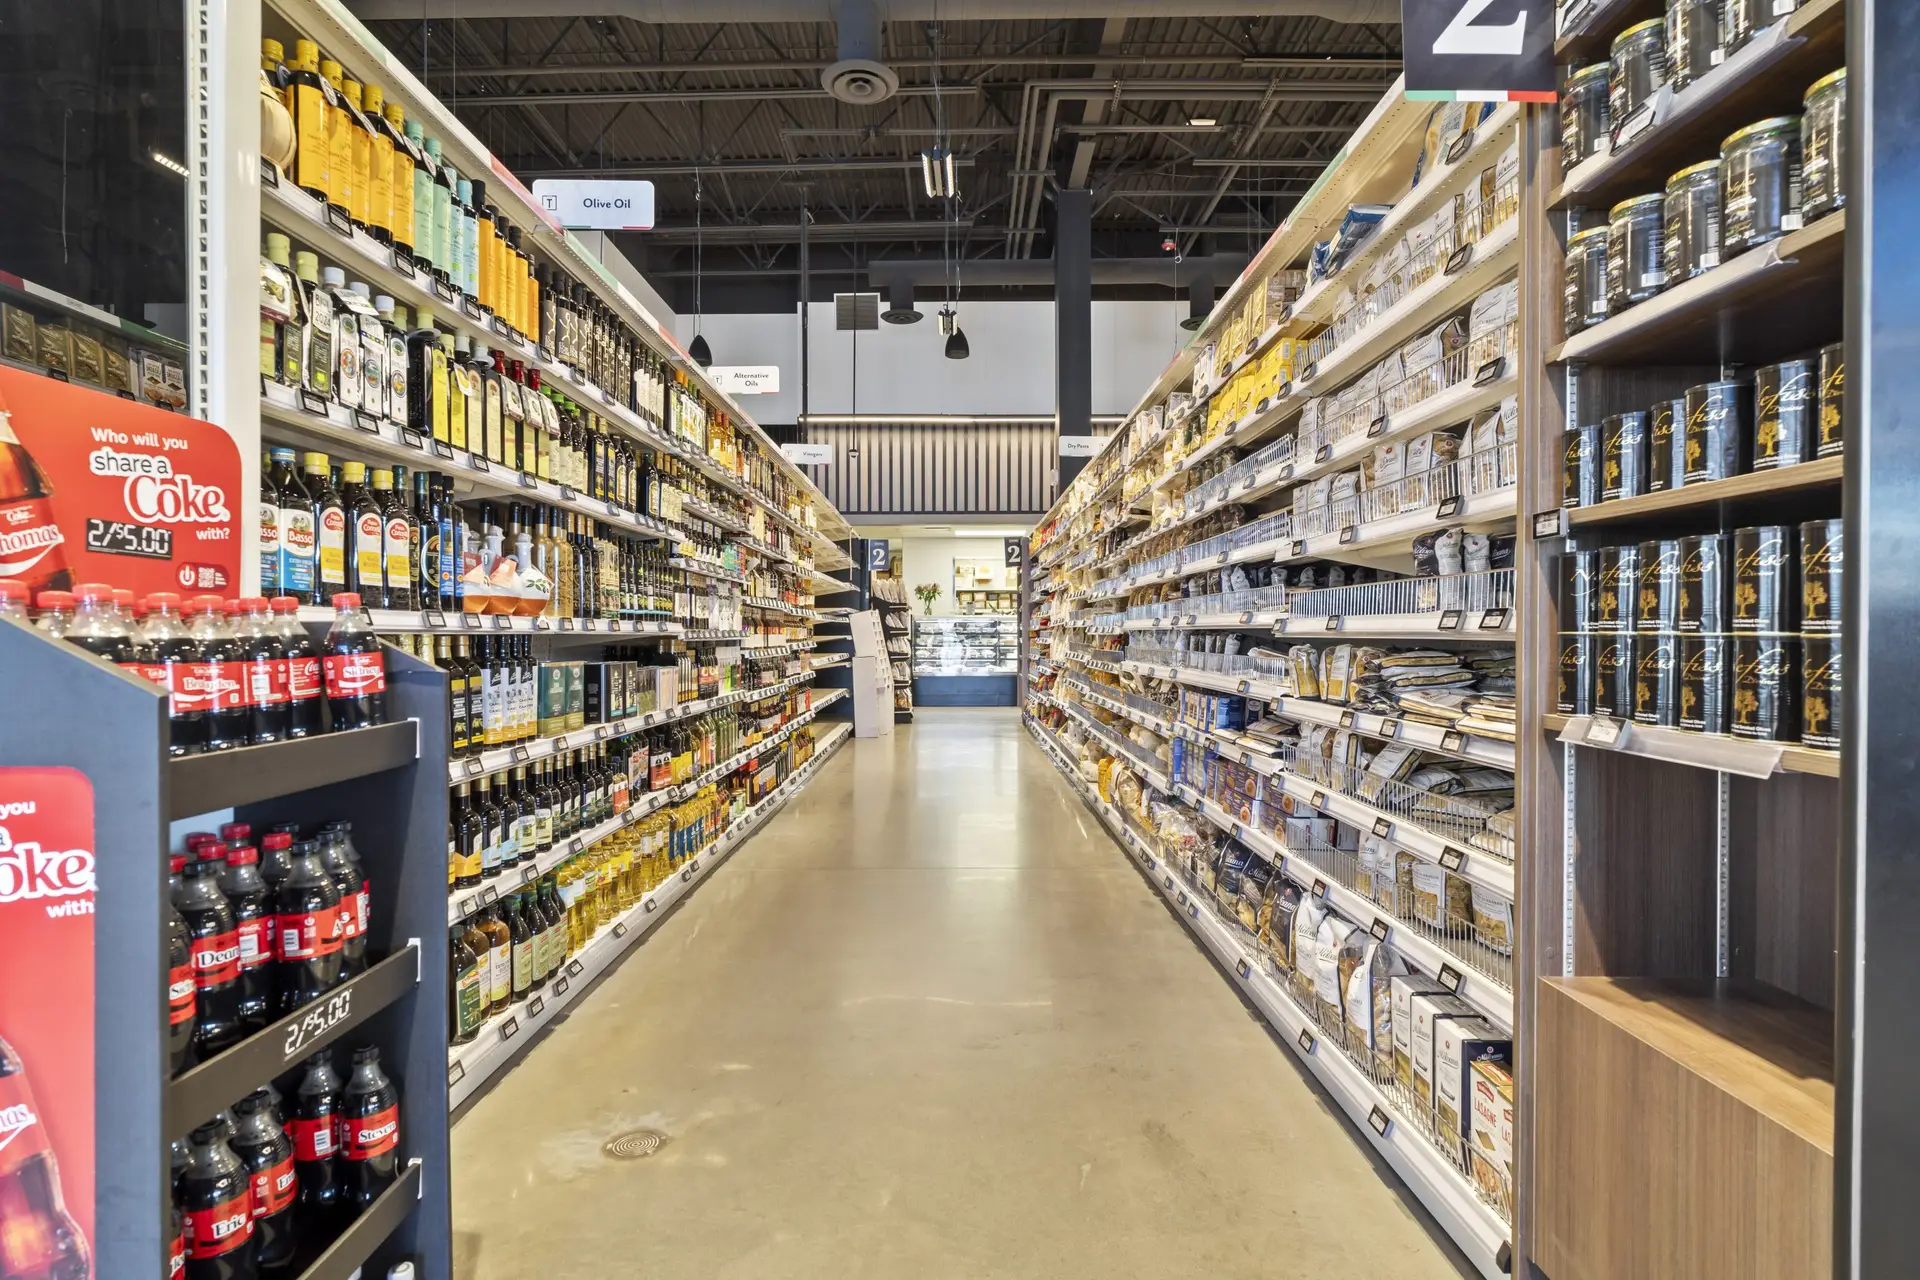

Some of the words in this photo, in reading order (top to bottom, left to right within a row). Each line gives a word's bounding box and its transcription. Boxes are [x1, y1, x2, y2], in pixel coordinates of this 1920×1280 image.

[583, 198, 612, 208] Olive
[614, 198, 631, 208] Oil
[91, 427, 128, 444] Who
[132, 433, 160, 447] will
[162, 437, 188, 450] you
[94, 452, 152, 473] share
[156, 459, 169, 474] a
[126, 474, 225, 521] Coke
[0, 528, 58, 552] homas
[196, 527, 230, 540] with?
[288, 530, 312, 544] Basso
[872, 548, 886, 566] 2
[1007, 545, 1021, 563] 2
[0, 800, 36, 820] you
[0, 846, 91, 897] oke
[46, 899, 94, 918] with
[1474, 1096, 1497, 1128] LASAGNE
[360, 1123, 396, 1142] Steven
[214, 1214, 245, 1237] Eric
